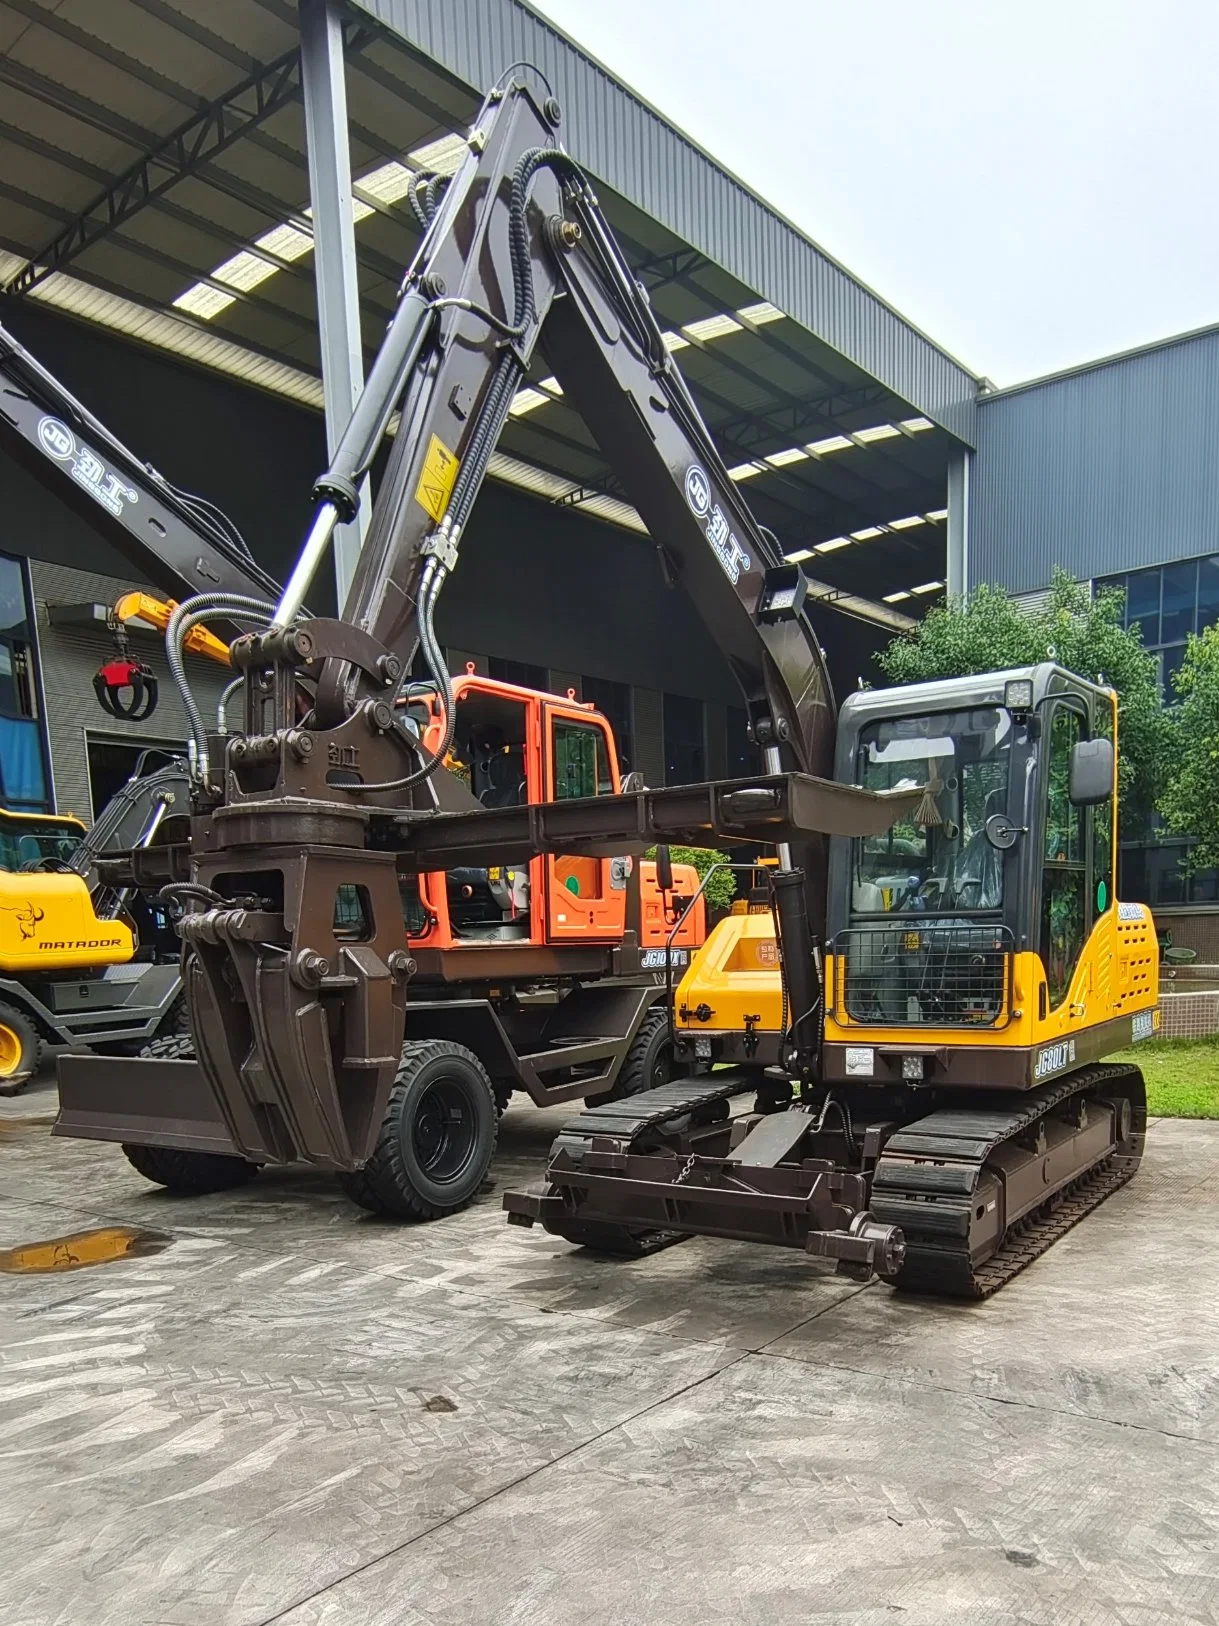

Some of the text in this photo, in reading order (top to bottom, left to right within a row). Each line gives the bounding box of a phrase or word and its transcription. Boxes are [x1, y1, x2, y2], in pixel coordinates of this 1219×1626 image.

[43, 424, 71, 454] JG
[689, 475, 708, 510] JG
[39, 939, 121, 949] MATADOR
[1035, 1043, 1068, 1077] JG80LT
